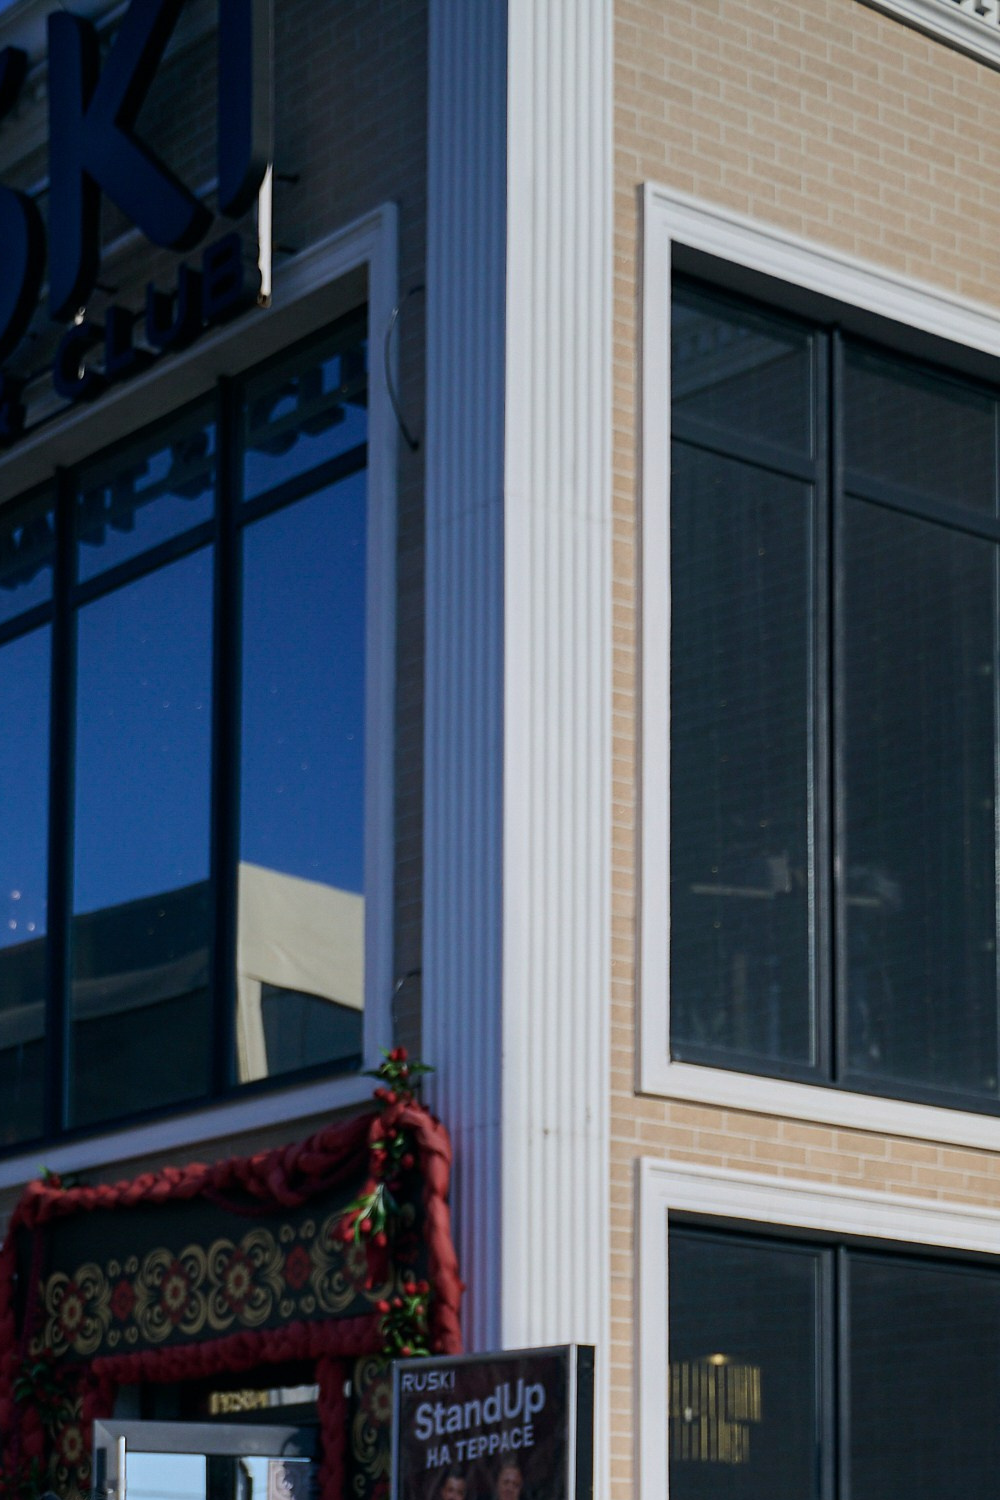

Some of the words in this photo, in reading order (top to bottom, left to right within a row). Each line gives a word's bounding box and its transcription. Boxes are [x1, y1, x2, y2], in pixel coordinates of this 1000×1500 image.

[53, 232, 246, 398] CLUB
[402, 1370, 456, 1392] RUSKI
[414, 1378, 547, 1441] StandUp
[425, 1444, 453, 1469] НА
[455, 1424, 535, 1463] ТЕРРАСЕ
